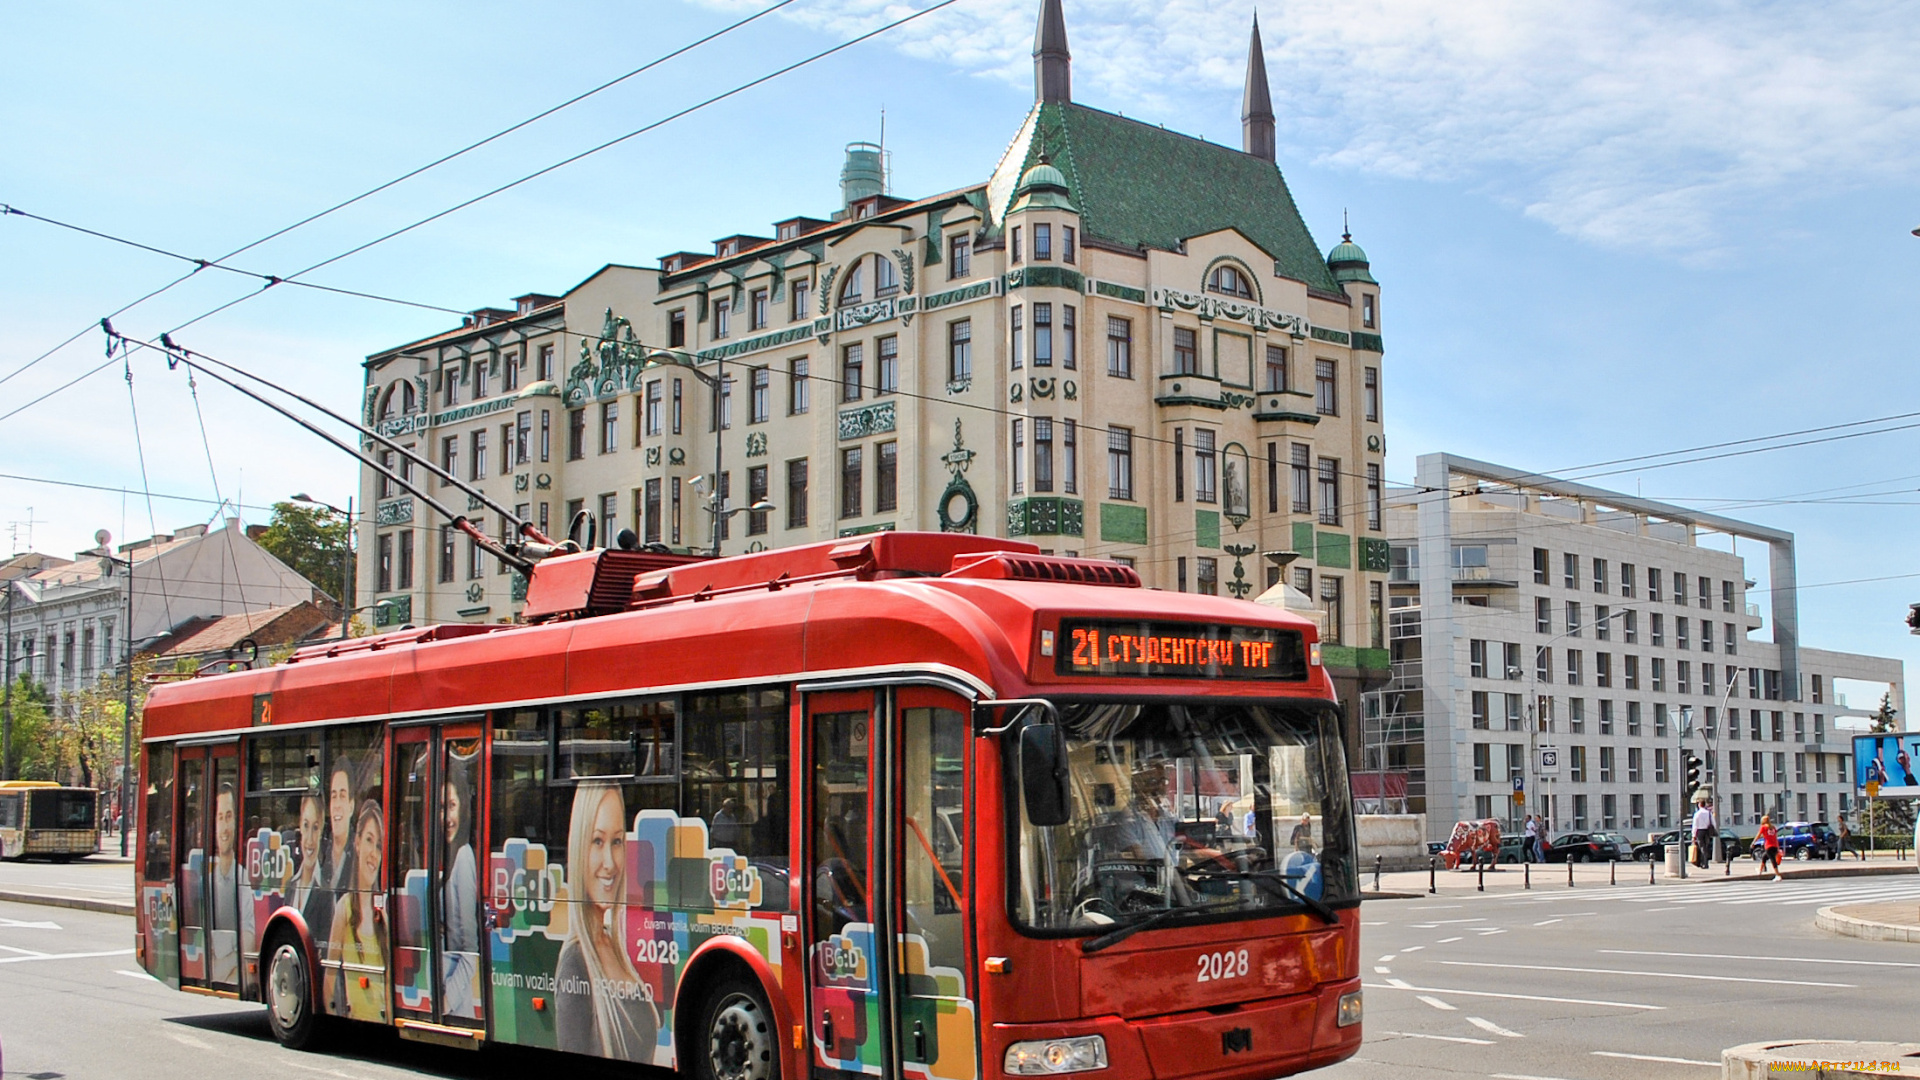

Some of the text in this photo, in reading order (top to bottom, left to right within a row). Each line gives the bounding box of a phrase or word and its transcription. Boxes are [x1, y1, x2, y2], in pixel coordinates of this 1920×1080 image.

[1071, 628, 1274, 668] 21 СТУДЕНТСКИ ТРГ
[261, 700, 272, 723] 21
[1515, 778, 1521, 790] P
[1868, 768, 1875, 779] P
[252, 848, 286, 879] BG:D
[494, 867, 556, 912] BG:D
[715, 868, 754, 892] BG:D
[636, 938, 679, 965] 2028
[824, 945, 860, 969] BG:D
[1197, 949, 1249, 982] 2028
[491, 966, 523, 988] čuvam
[526, 972, 558, 993] vozila,
[560, 975, 590, 996] volim
